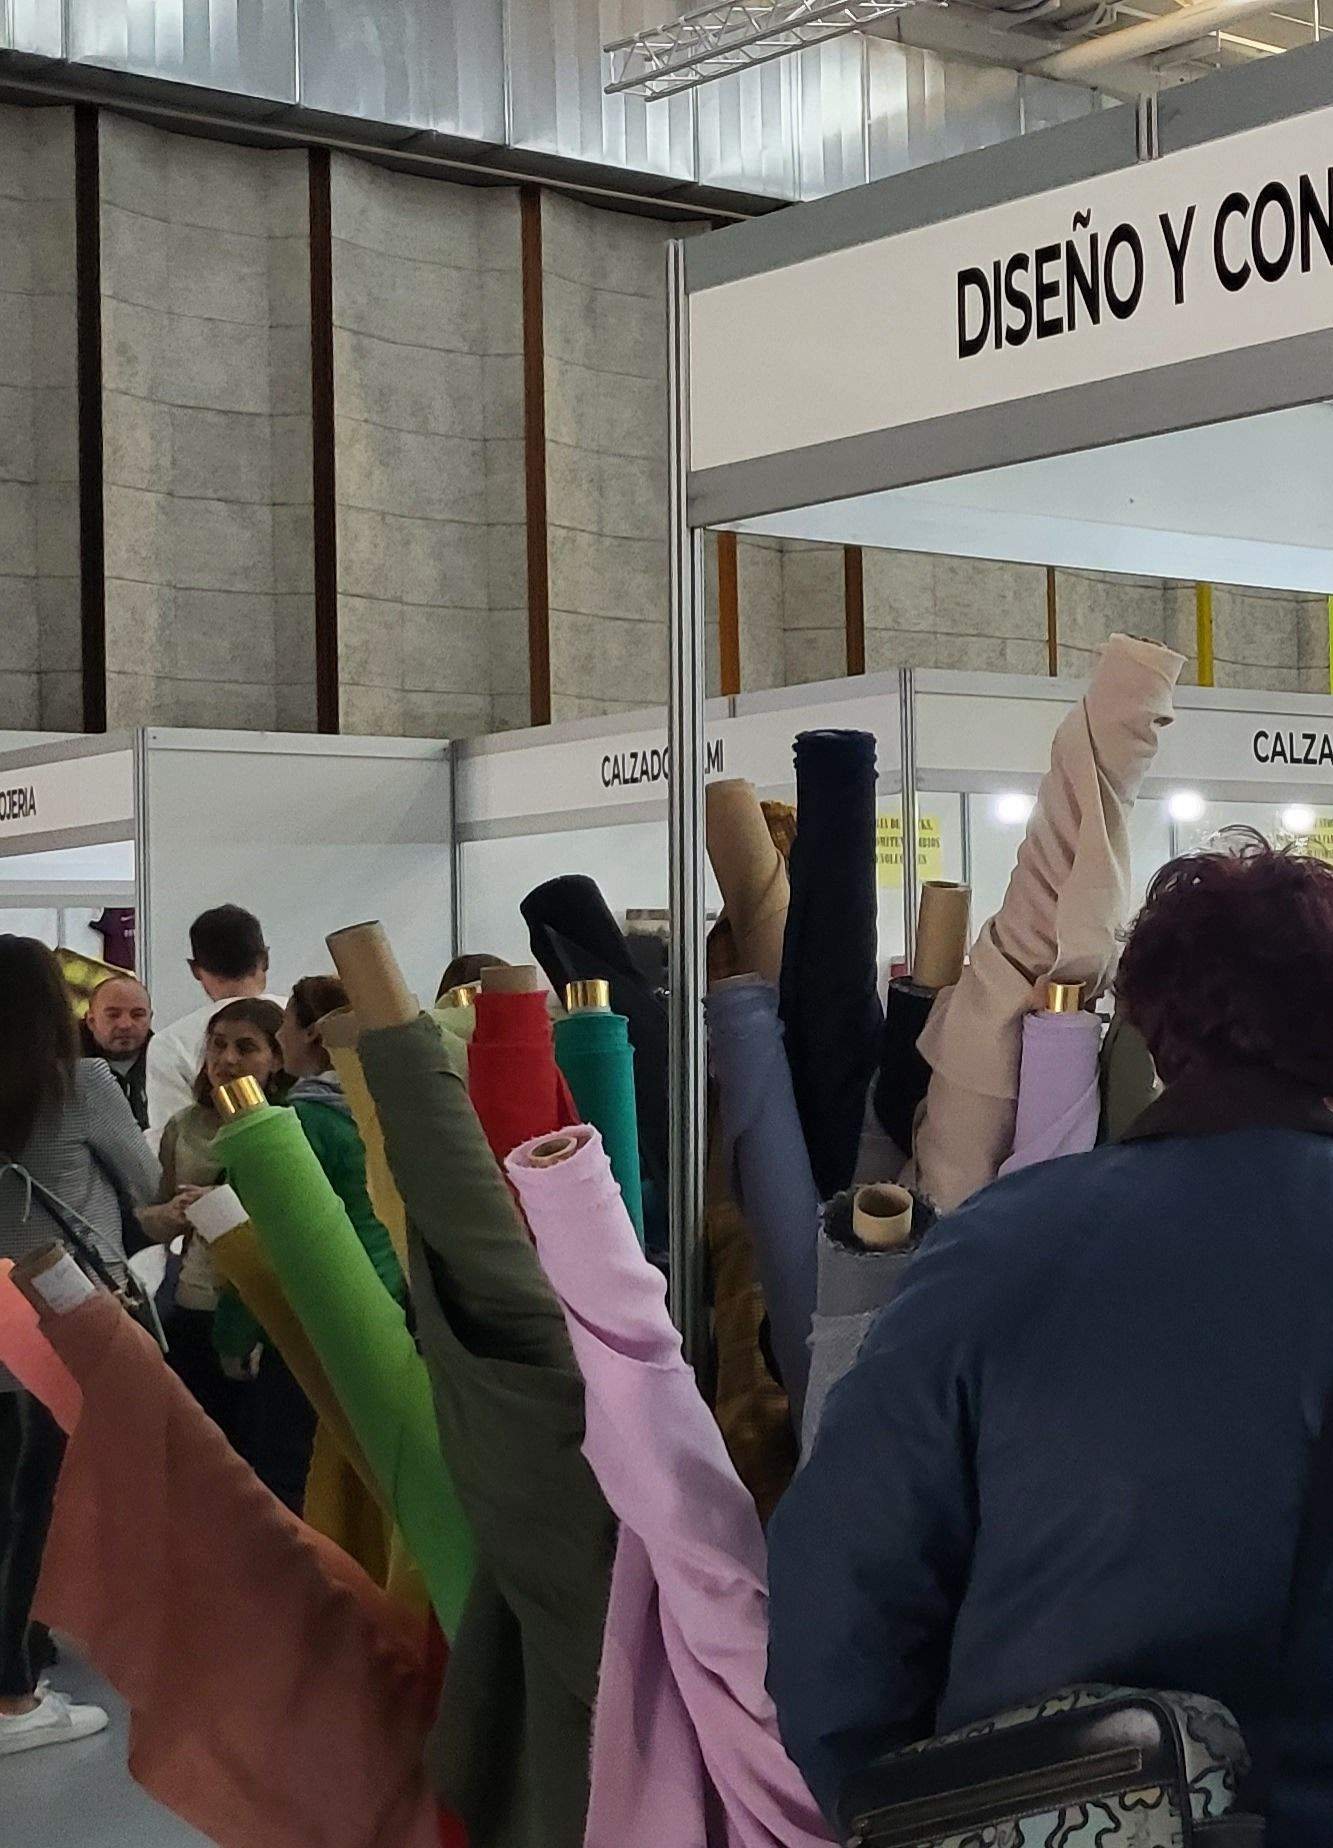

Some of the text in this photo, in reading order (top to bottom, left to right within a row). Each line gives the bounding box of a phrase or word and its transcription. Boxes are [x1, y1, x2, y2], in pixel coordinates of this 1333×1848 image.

[957, 208, 1144, 359] DISEÑO
[1158, 204, 1197, 305] Y
[601, 746, 669, 787] CALZADO
